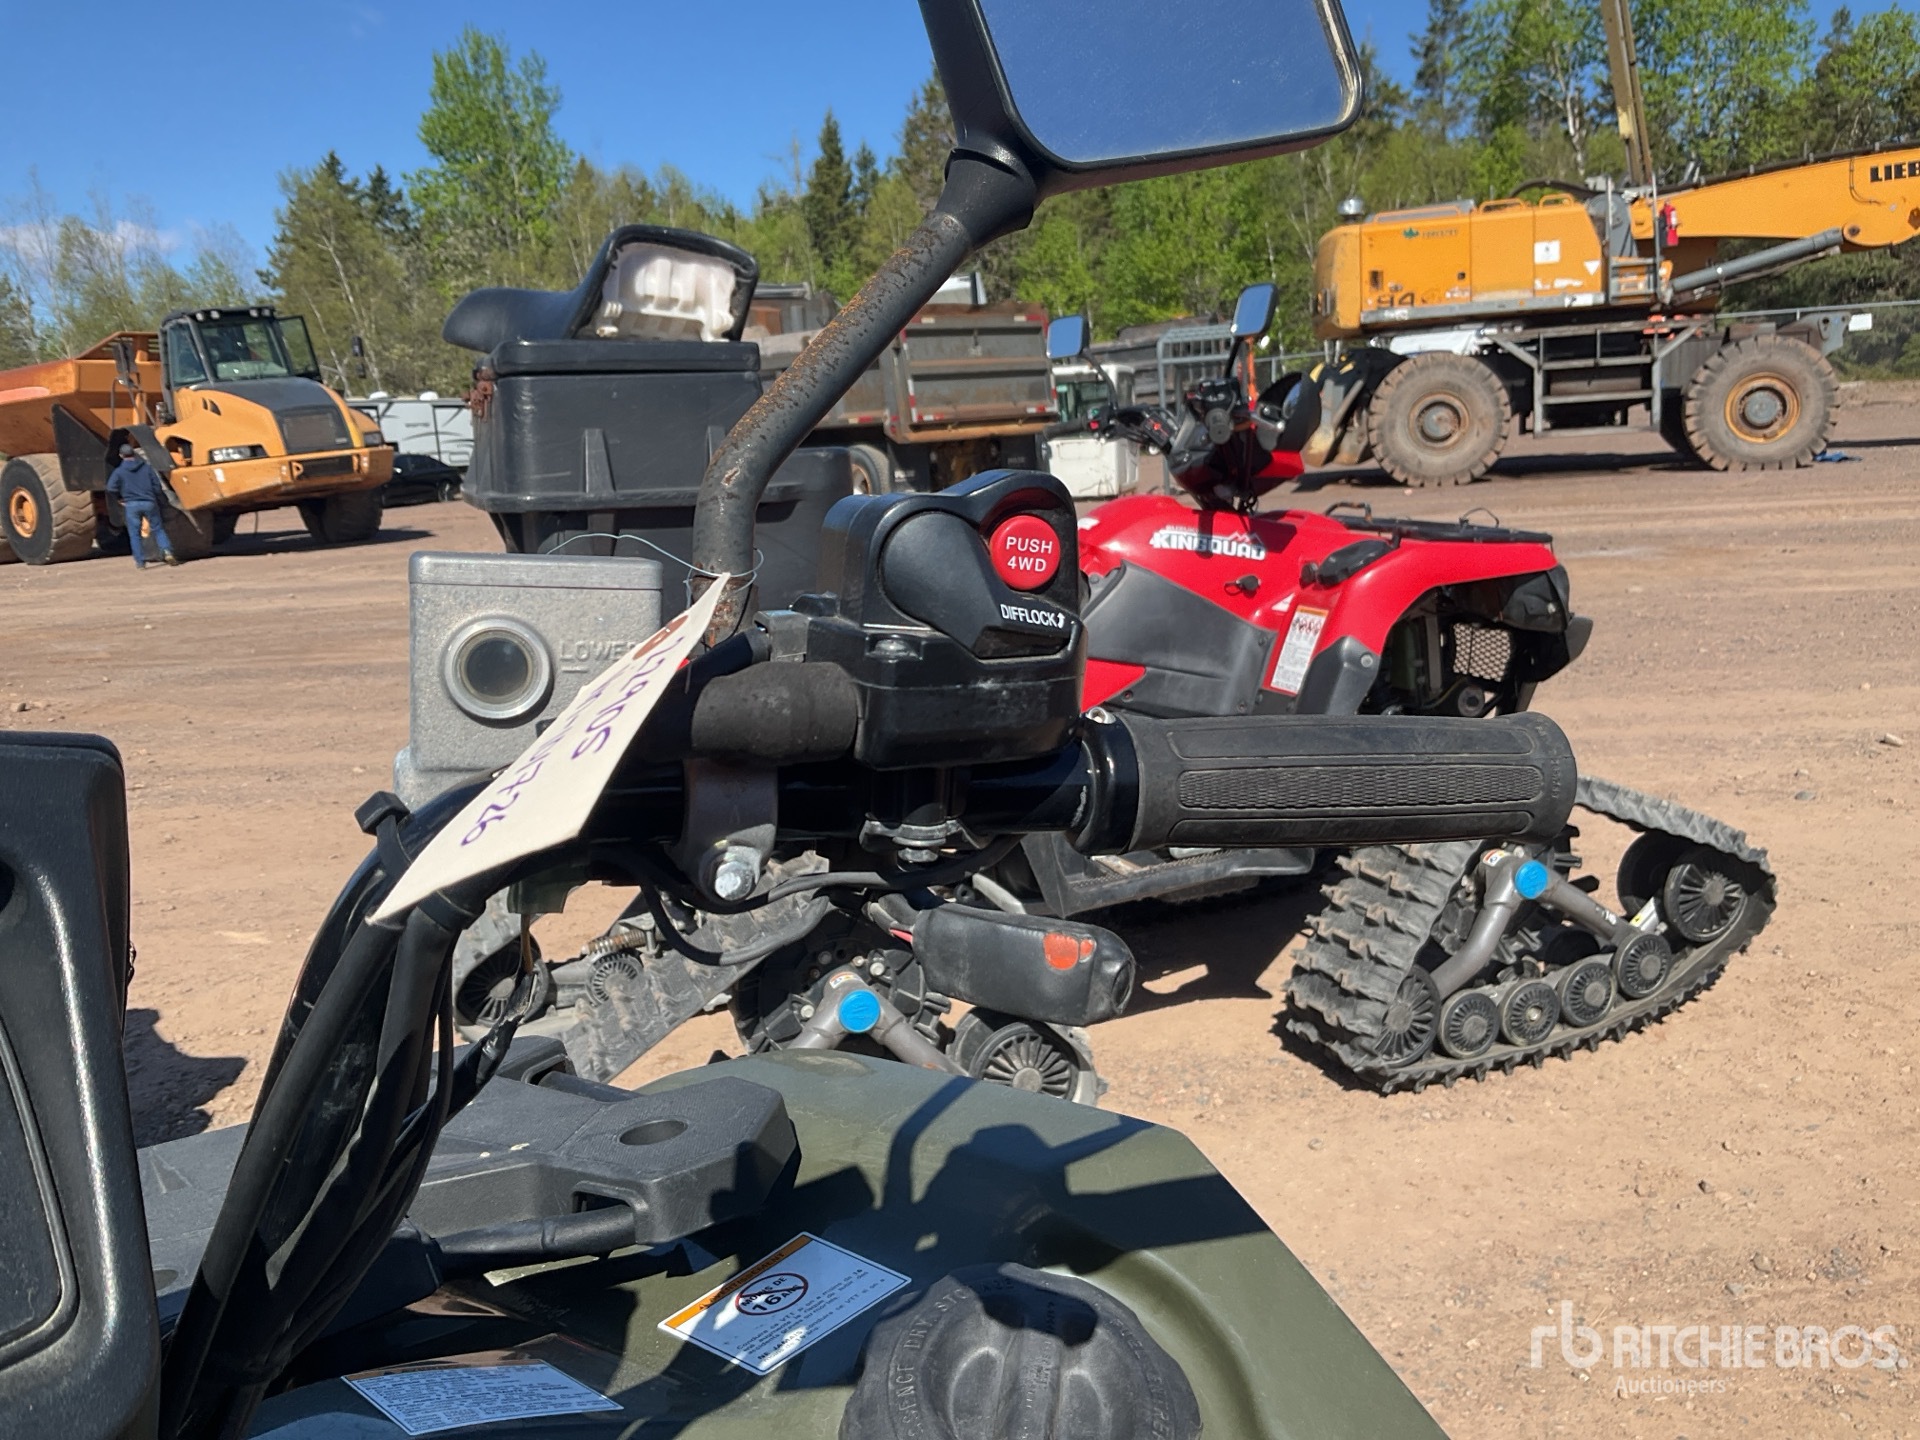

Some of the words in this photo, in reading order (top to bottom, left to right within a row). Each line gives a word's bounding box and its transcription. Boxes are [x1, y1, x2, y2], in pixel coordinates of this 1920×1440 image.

[1006, 536, 1053, 554] PUSH
[1149, 529, 1266, 561] KINGQUAD
[1007, 556, 1047, 572] 4WD
[1000, 604, 1058, 627] DIFFLOCK
[752, 1295, 782, 1311] 16
